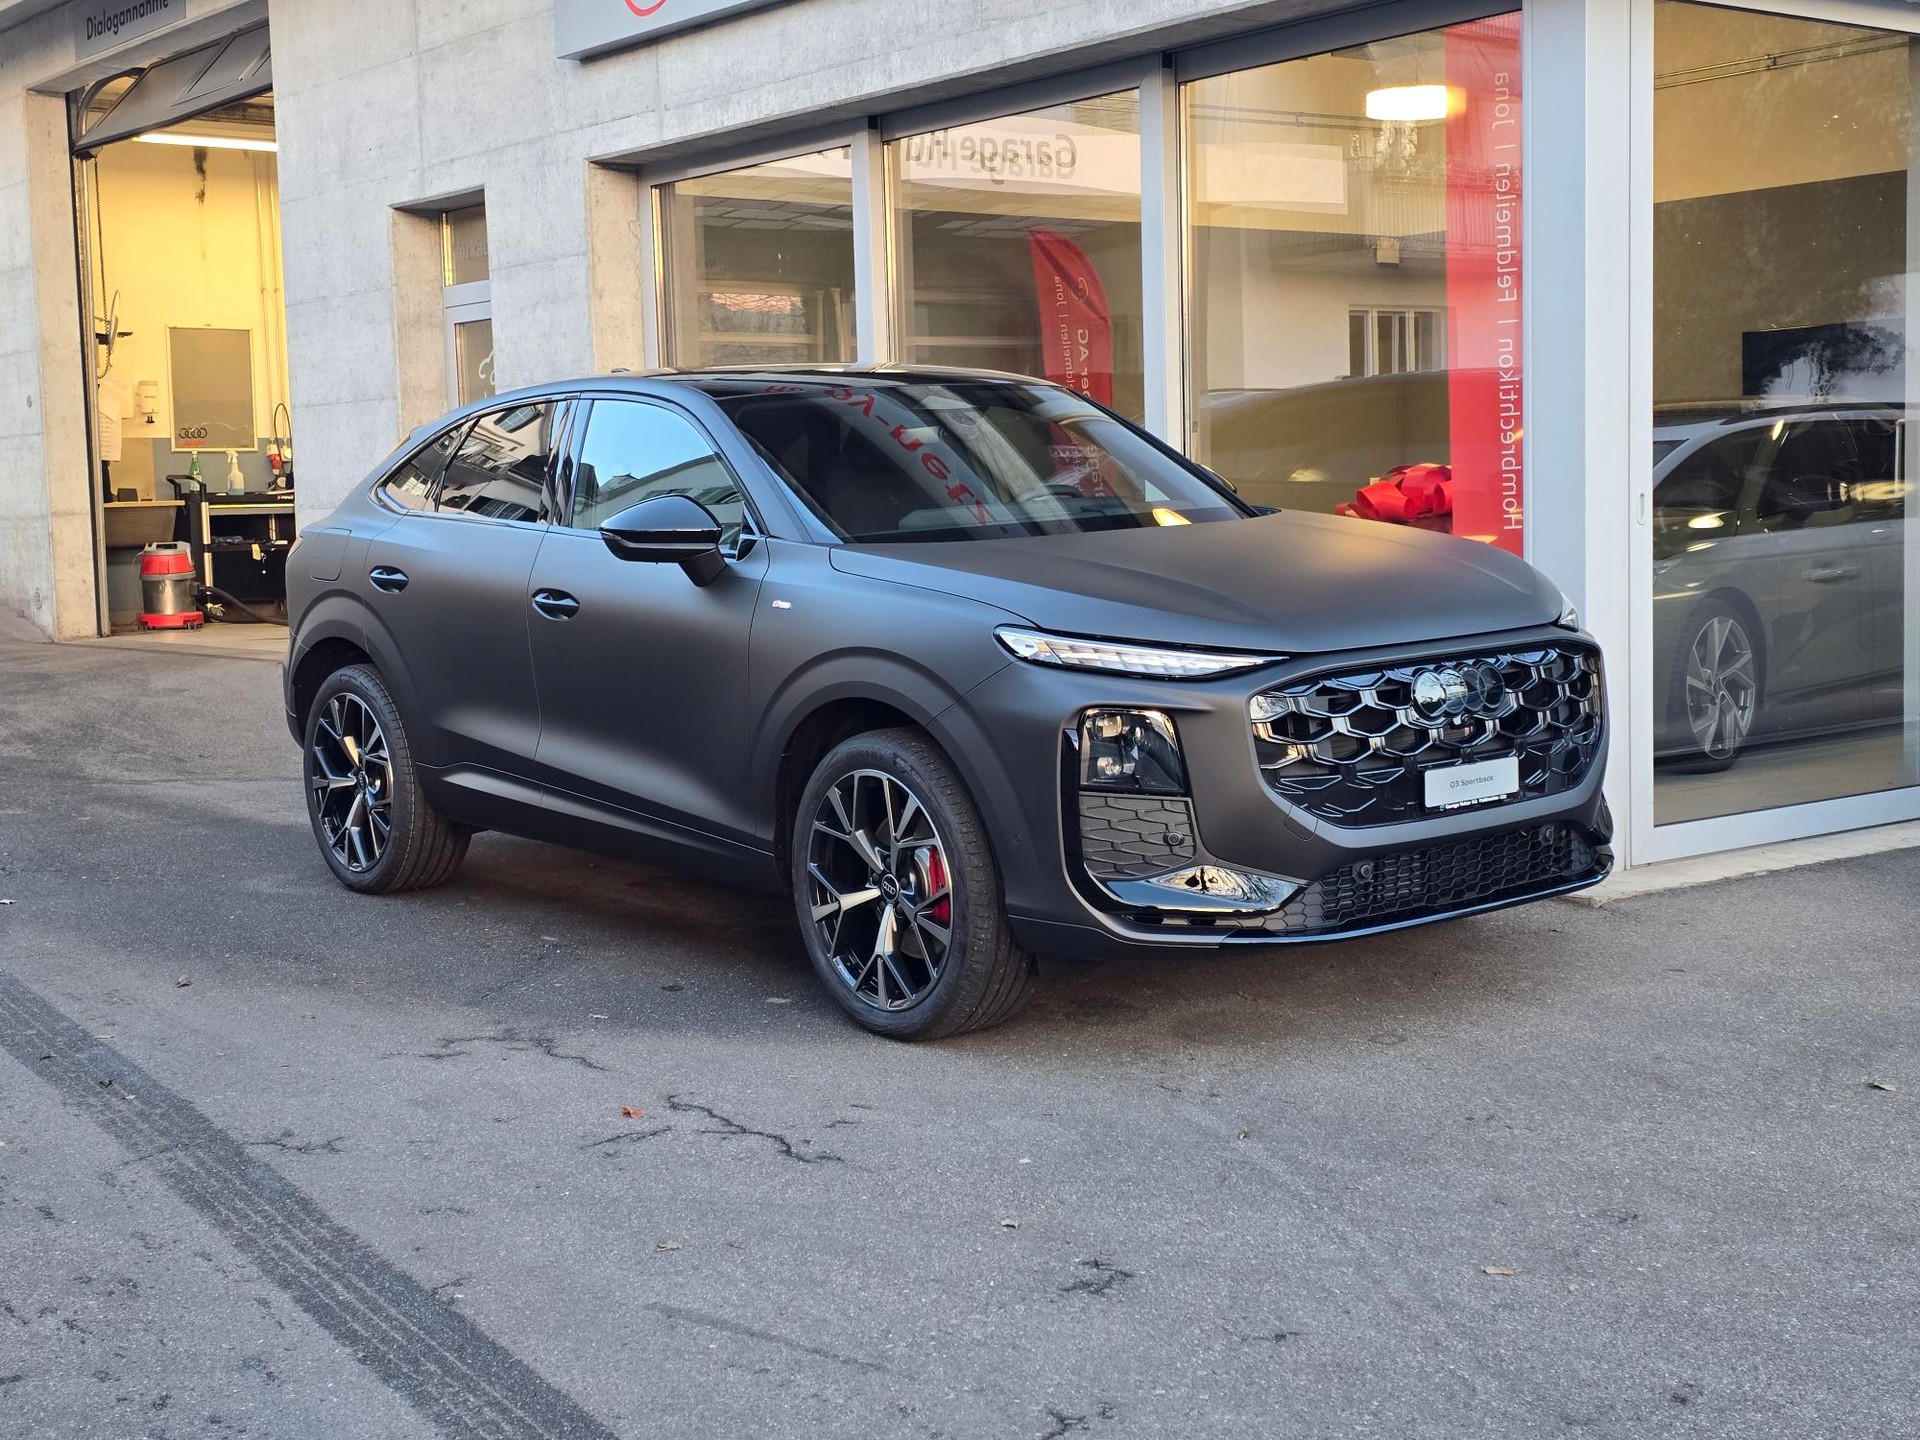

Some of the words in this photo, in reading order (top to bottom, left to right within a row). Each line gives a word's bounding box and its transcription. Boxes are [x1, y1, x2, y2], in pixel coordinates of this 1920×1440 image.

[86, 0, 169, 40] Dialogannahme
[1449, 780, 1460, 789] Q3
[1460, 775, 1494, 789] Sportback
